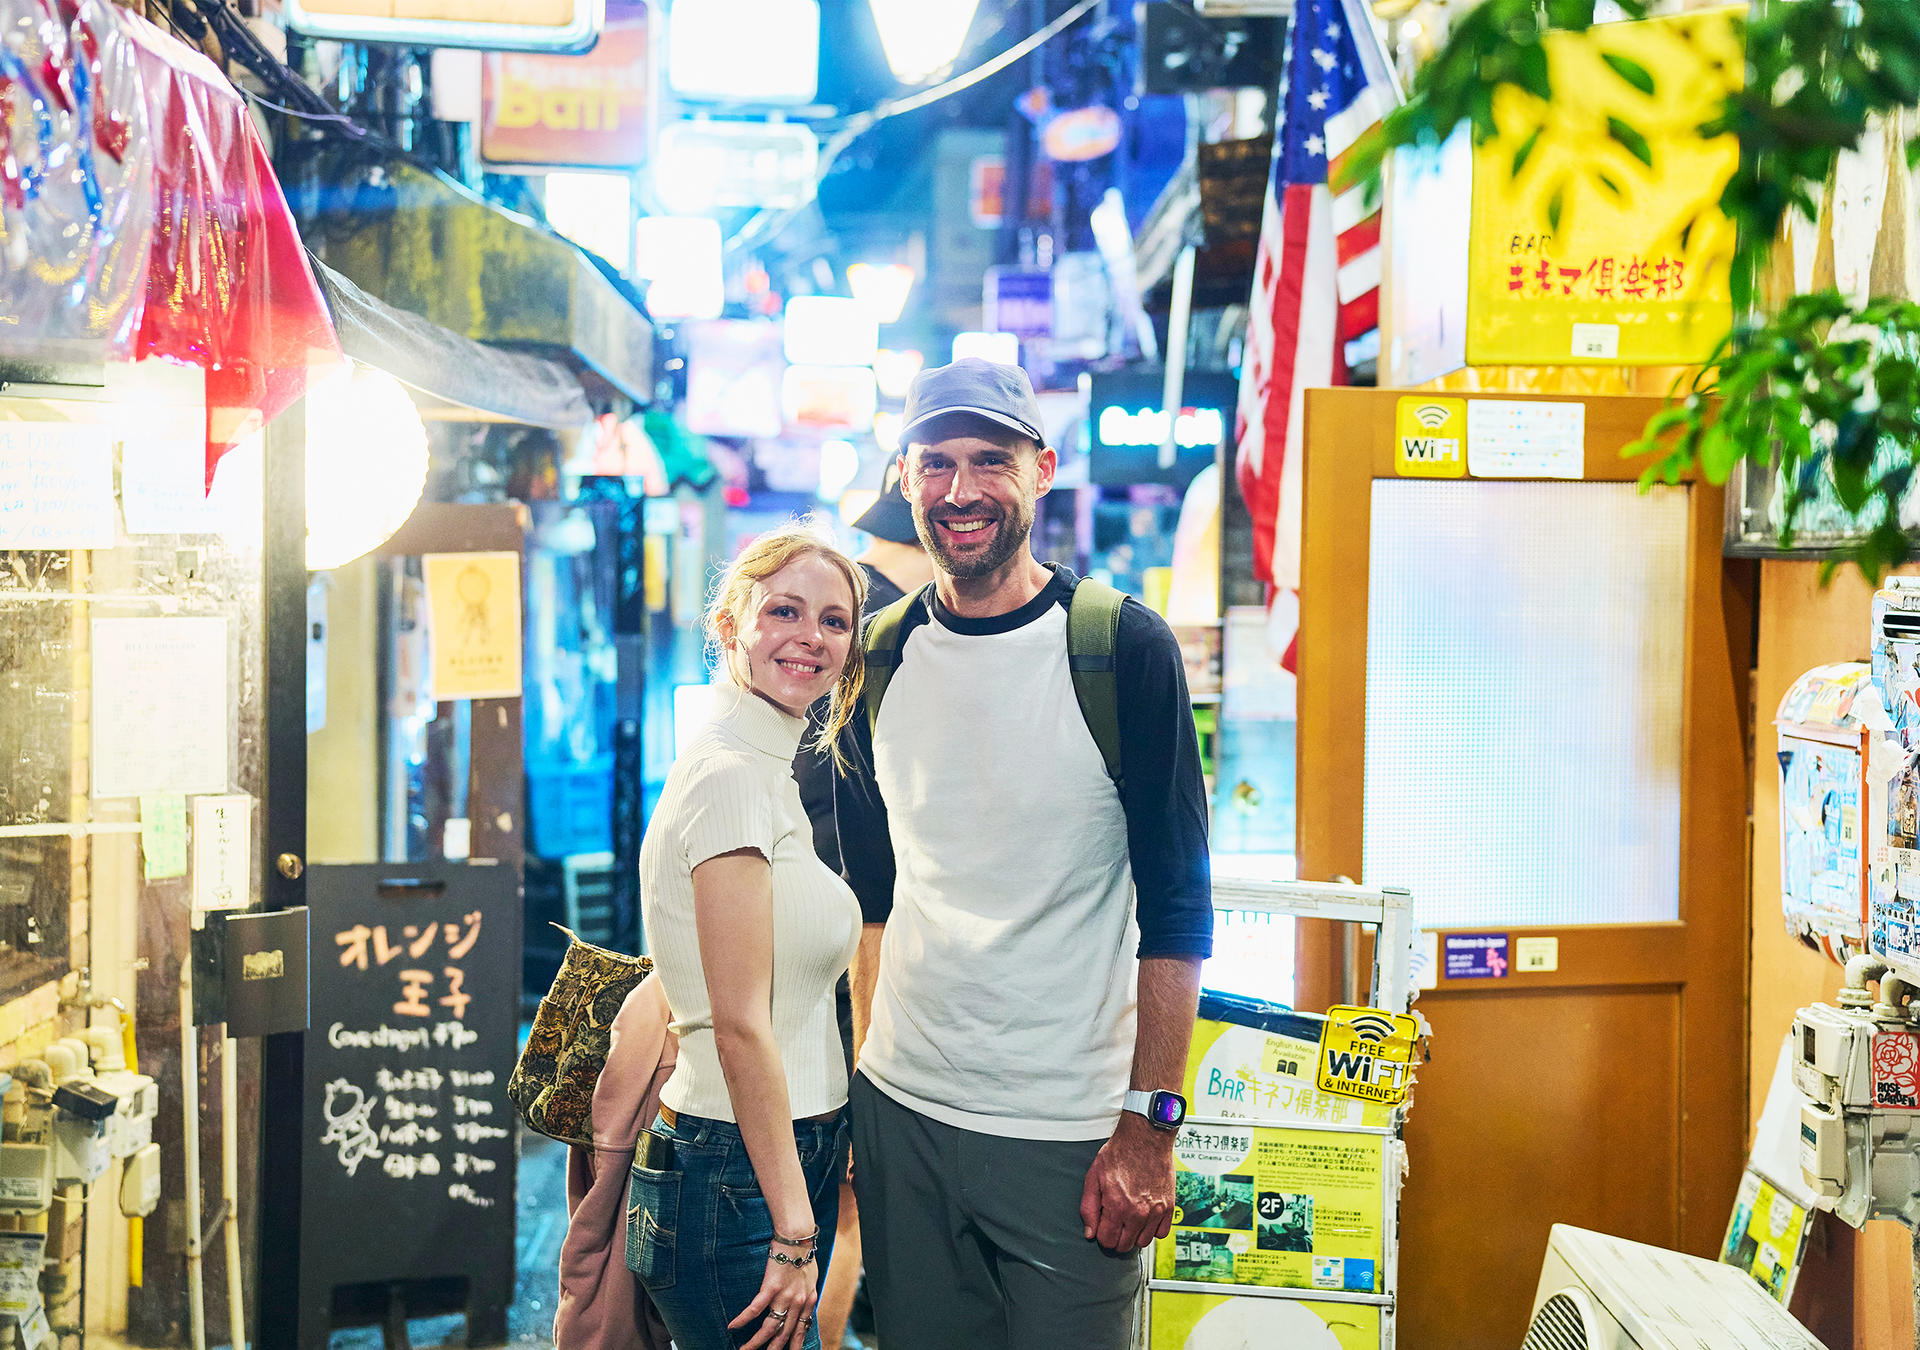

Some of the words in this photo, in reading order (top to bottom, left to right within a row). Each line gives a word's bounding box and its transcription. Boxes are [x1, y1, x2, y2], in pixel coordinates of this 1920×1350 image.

[1405, 438, 1459, 462] WiFi
[335, 910, 482, 971] オレンジ
[393, 966, 472, 1019] 王子
[1350, 1041, 1386, 1057] FREE
[1328, 1049, 1403, 1089] WiFi
[1208, 1067, 1245, 1102] BAR
[1324, 1078, 1333, 1088] &
[1337, 1080, 1398, 1101] INTERNET
[1877, 1082, 1901, 1094] ROSE
[1877, 1092, 1916, 1107] GARDEN
[1261, 1198, 1281, 1213] 2F
